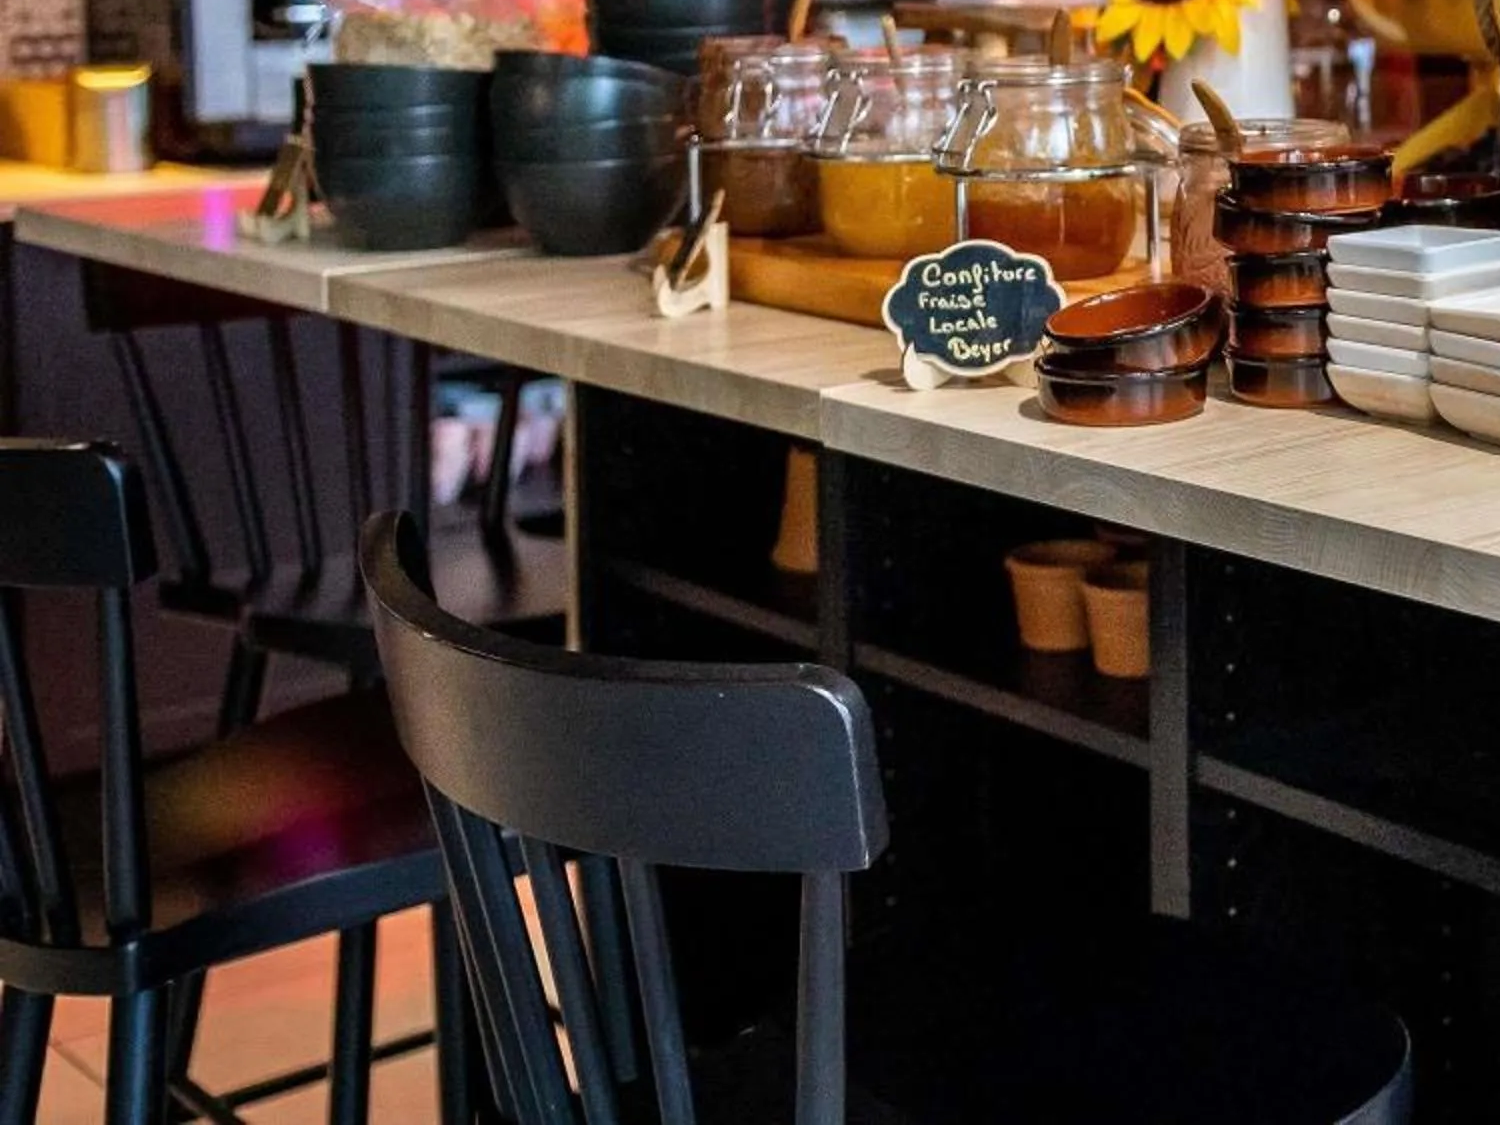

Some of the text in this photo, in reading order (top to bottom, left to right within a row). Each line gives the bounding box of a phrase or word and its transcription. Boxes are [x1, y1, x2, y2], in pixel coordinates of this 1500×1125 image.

[918, 292, 987, 310] Fraise
[929, 309, 999, 335] Locale
[947, 336, 1012, 363] Beyer
